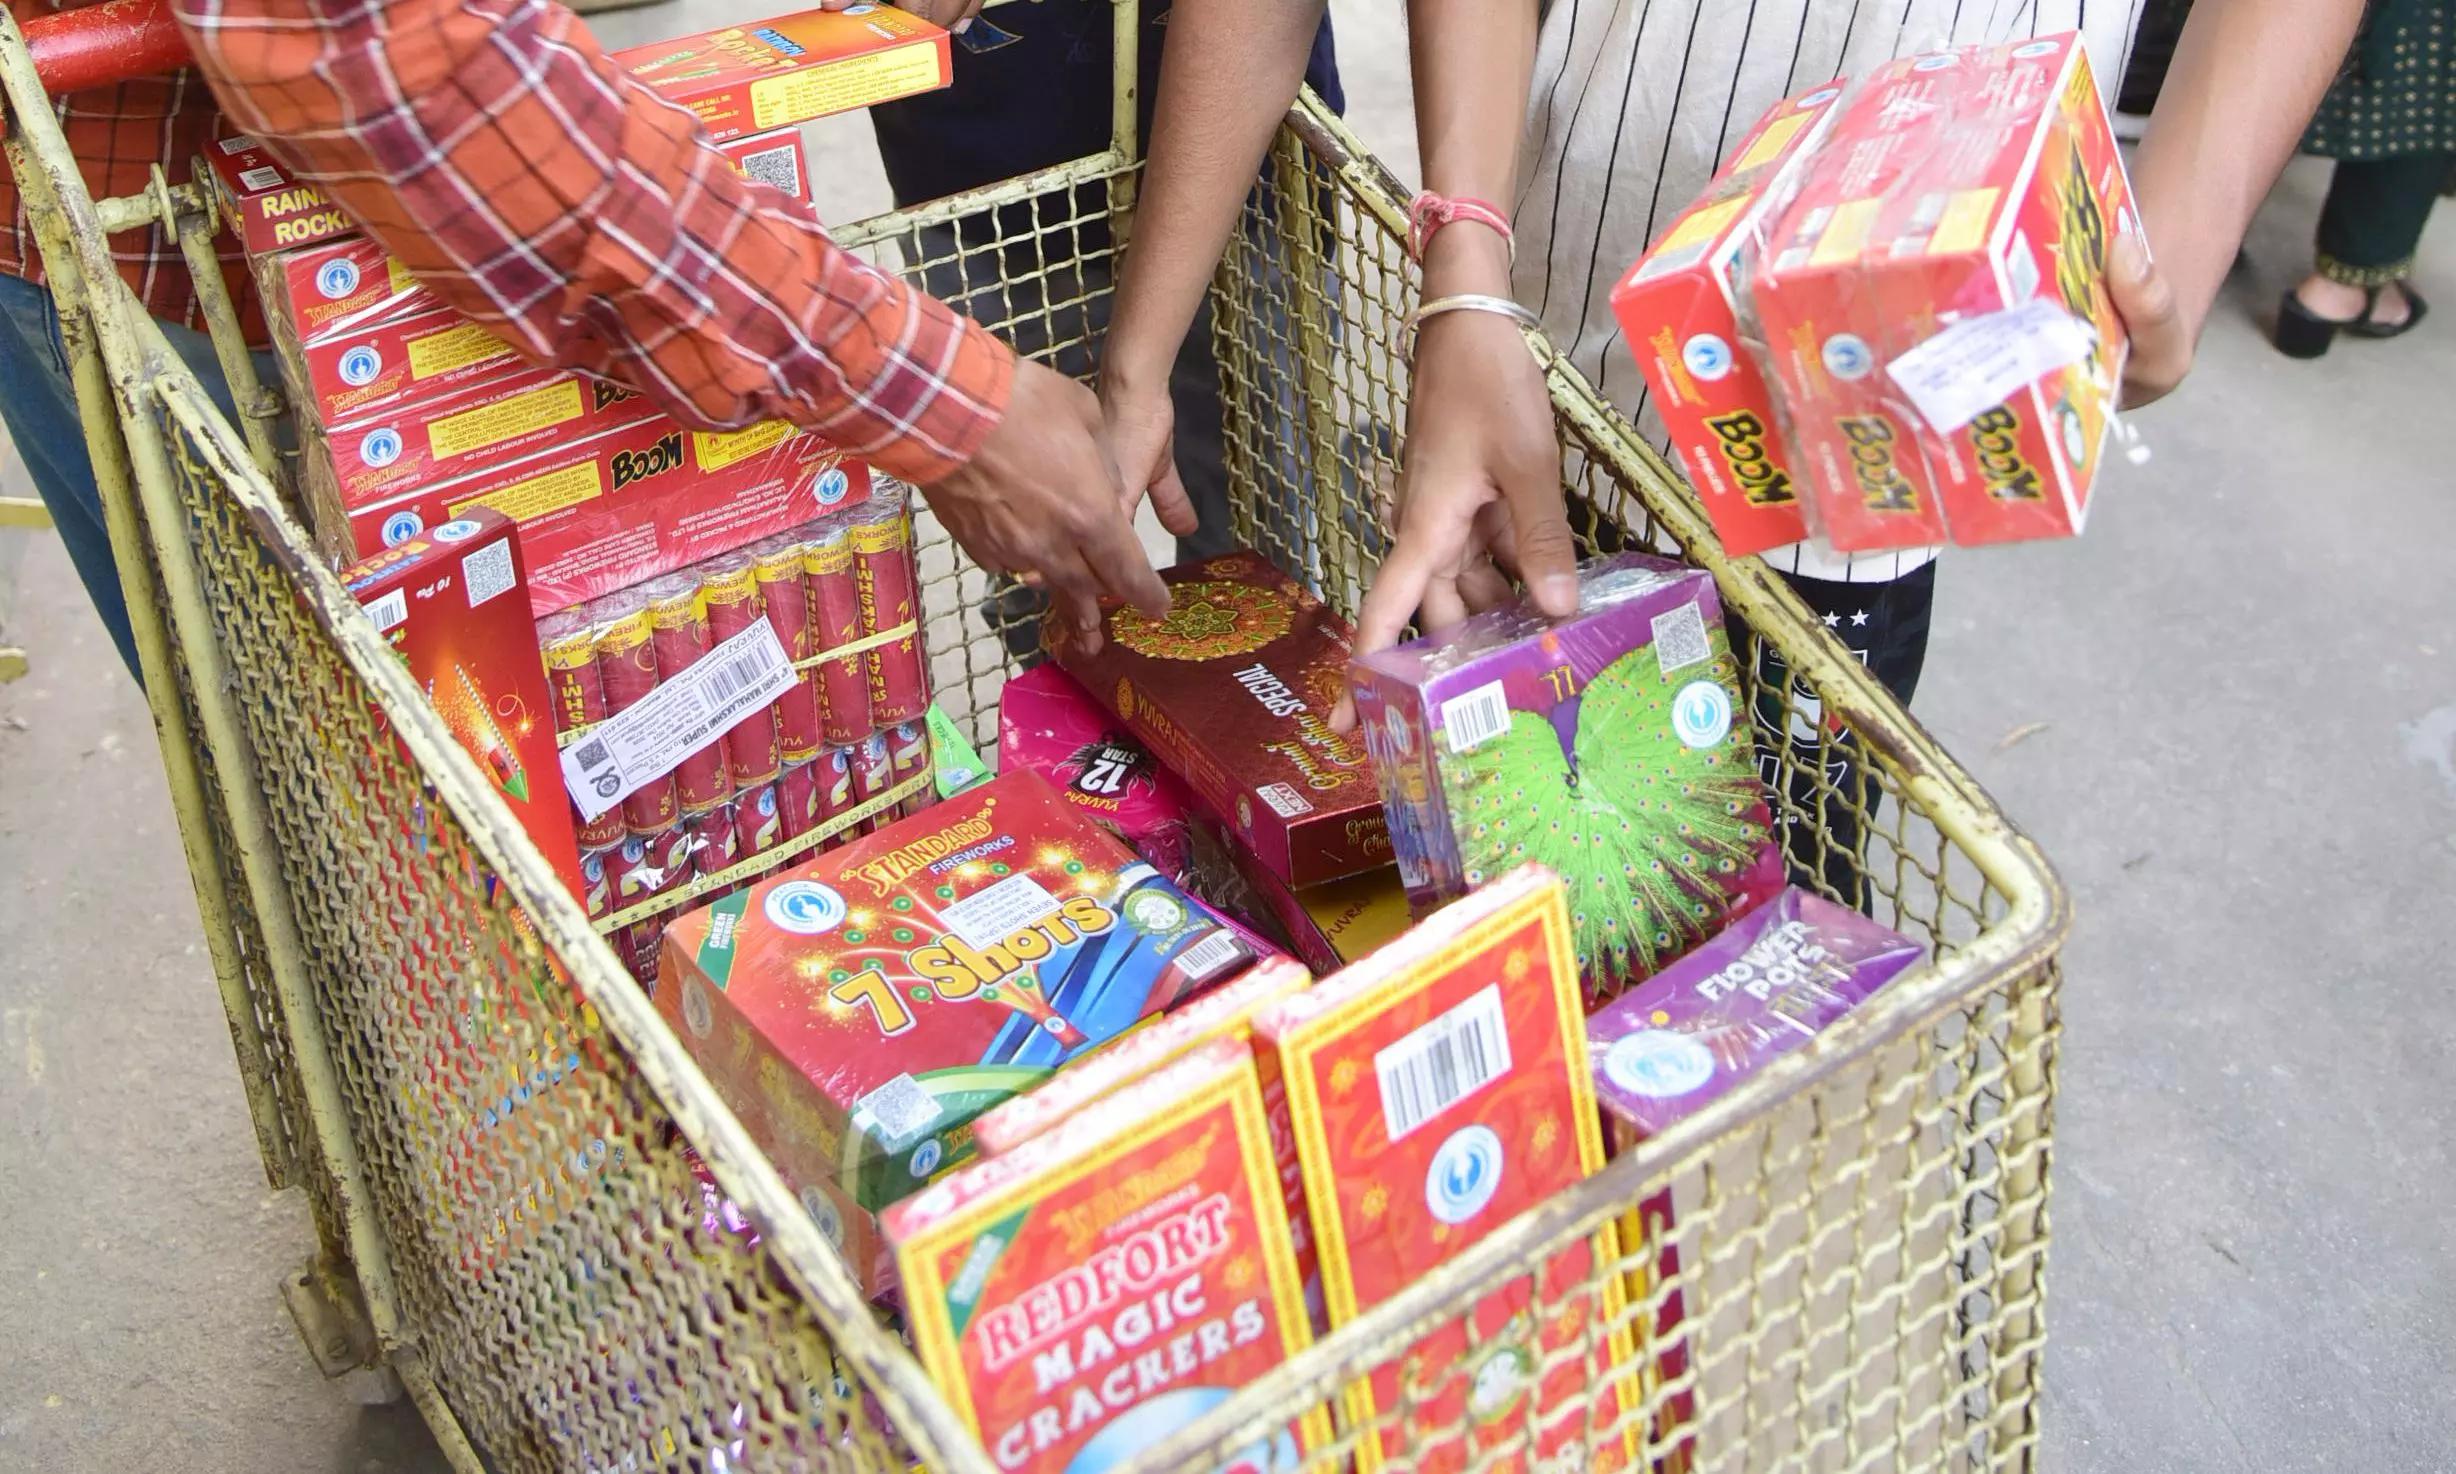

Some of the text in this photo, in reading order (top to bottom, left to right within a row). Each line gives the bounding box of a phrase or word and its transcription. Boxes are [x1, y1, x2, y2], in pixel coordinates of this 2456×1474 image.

[261, 186, 330, 219] RAIN
[274, 209, 352, 245] ROCK
[611, 431, 684, 493] BOOM
[1705, 410, 1796, 508] BOOM
[1836, 414, 1922, 514] BOOM
[1970, 403, 2045, 501] BOOM
[725, 622, 767, 653] YUVRAJ
[759, 673, 781, 691] SHRI
[1232, 662, 1308, 718] SPECIAL
[705, 686, 764, 728] MAHALAKSHMI
[680, 723, 709, 746] SUPER
[1100, 746, 1137, 764] STAR
[1078, 756, 1127, 796] 12
[1062, 789, 1119, 812] YUVRAJ
[1345, 814, 1386, 845] Groun
[1363, 832, 1393, 857] Cha
[928, 834, 1015, 878] FIREWORKS
[708, 911, 728, 949] GREEN
[829, 967, 915, 1035] 7
[906, 896, 1120, 1002] Shots
[1695, 920, 1818, 1001] FLOWER
[1744, 945, 1827, 1001] POTS
[978, 1195, 1229, 1370] REDFORT
[1032, 1271, 1207, 1395] MAGIC
[994, 1298, 1266, 1469] CRACKERS
